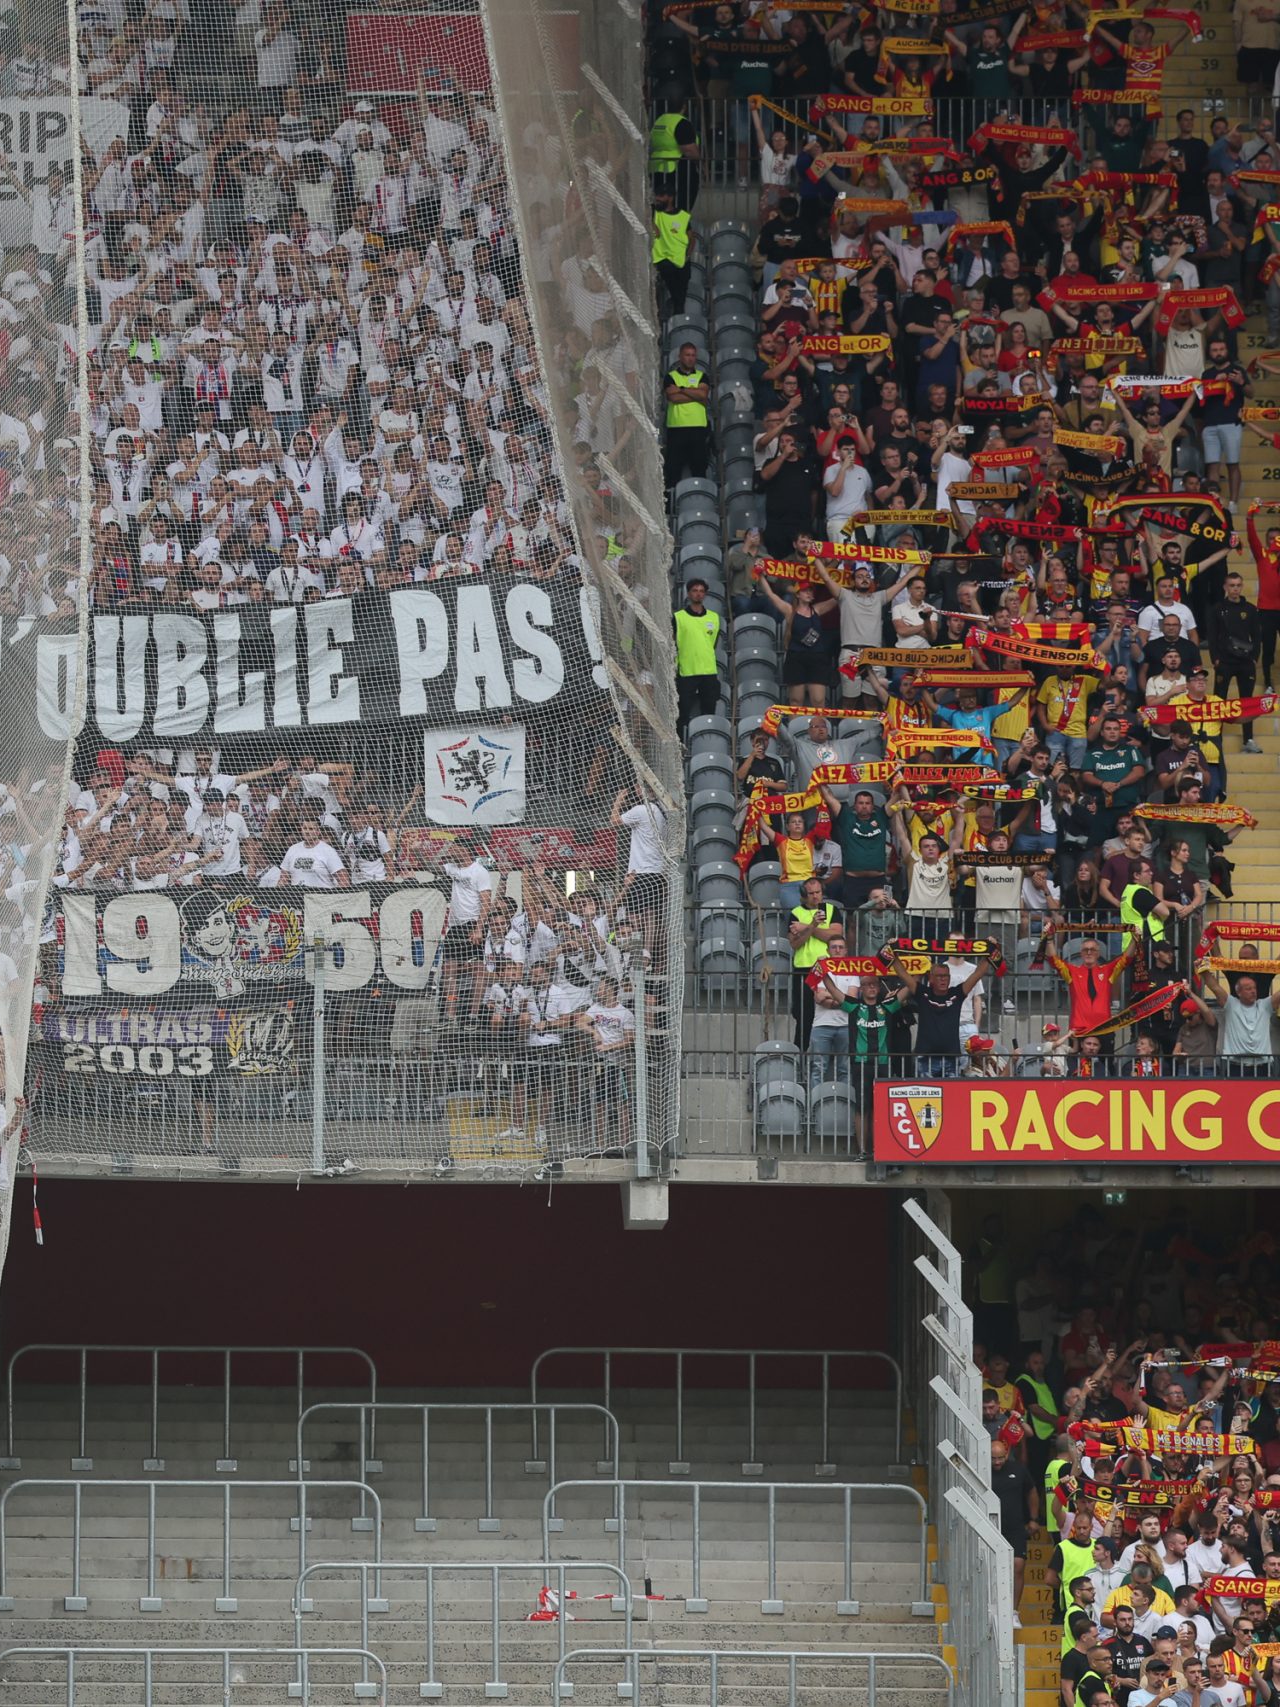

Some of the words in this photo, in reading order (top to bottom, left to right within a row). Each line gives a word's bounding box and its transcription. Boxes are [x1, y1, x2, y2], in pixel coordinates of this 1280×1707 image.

[1201, 59, 1219, 71] 39
[827, 98, 870, 112] SANG
[875, 103, 886, 112] et
[890, 101, 913, 112] OR
[991, 127, 1019, 138] RACING
[1020, 130, 1039, 139] CLUB
[1047, 132, 1064, 140] LENS
[922, 172, 958, 187] ANG
[962, 169, 972, 182] &
[975, 167, 994, 181] OR
[1067, 287, 1096, 296] RACING
[1098, 287, 1117, 296] CLUB
[1126, 287, 1144, 295] LENS
[803, 338, 839, 351] ANG
[843, 340, 854, 350] et
[858, 337, 881, 349] OR
[1247, 336, 1266, 348] 32
[994, 452, 1013, 462] CLUB
[1065, 470, 1100, 483] RACING
[1142, 507, 1187, 530] SANG
[1190, 522, 1201, 536] &
[1202, 525, 1226, 543] OR
[834, 543, 858, 557] RC
[861, 545, 908, 561] LENS
[766, 560, 807, 580] SANG
[992, 638, 1031, 657] ALLEZ
[1032, 646, 1089, 662] LENSOIS
[870, 762, 898, 781] LEN
[903, 767, 943, 780] ALLEZ
[947, 766, 982, 780] LENS
[1096, 762, 1126, 771] Auchan
[981, 787, 1037, 800] LENS
[987, 854, 1011, 864] CLUB
[1014, 855, 1028, 864] DE
[983, 875, 1014, 884] Auchan
[1240, 926, 1261, 936] CLUB
[898, 938, 929, 951] RC
[931, 939, 989, 953] LENS
[181, 964, 231, 983] Virage
[231, 960, 266, 979] Sud
[265, 963, 304, 983] Lyon
[826, 960, 873, 975] SANG
[857, 1018, 886, 1028] Auchan
[63, 1044, 214, 1077] 2003
[970, 1089, 1223, 1151] RACING
[1157, 1434, 1173, 1445] MC
[1174, 1435, 1220, 1448] DONALD'S
[1083, 1482, 1112, 1500] RC
[1126, 1491, 1169, 1506] ENS
[1029, 1568, 1045, 1580] 18
[1213, 1579, 1264, 1594] SANG
[1035, 1590, 1050, 1601] 17
[1042, 1630, 1058, 1641] 15
